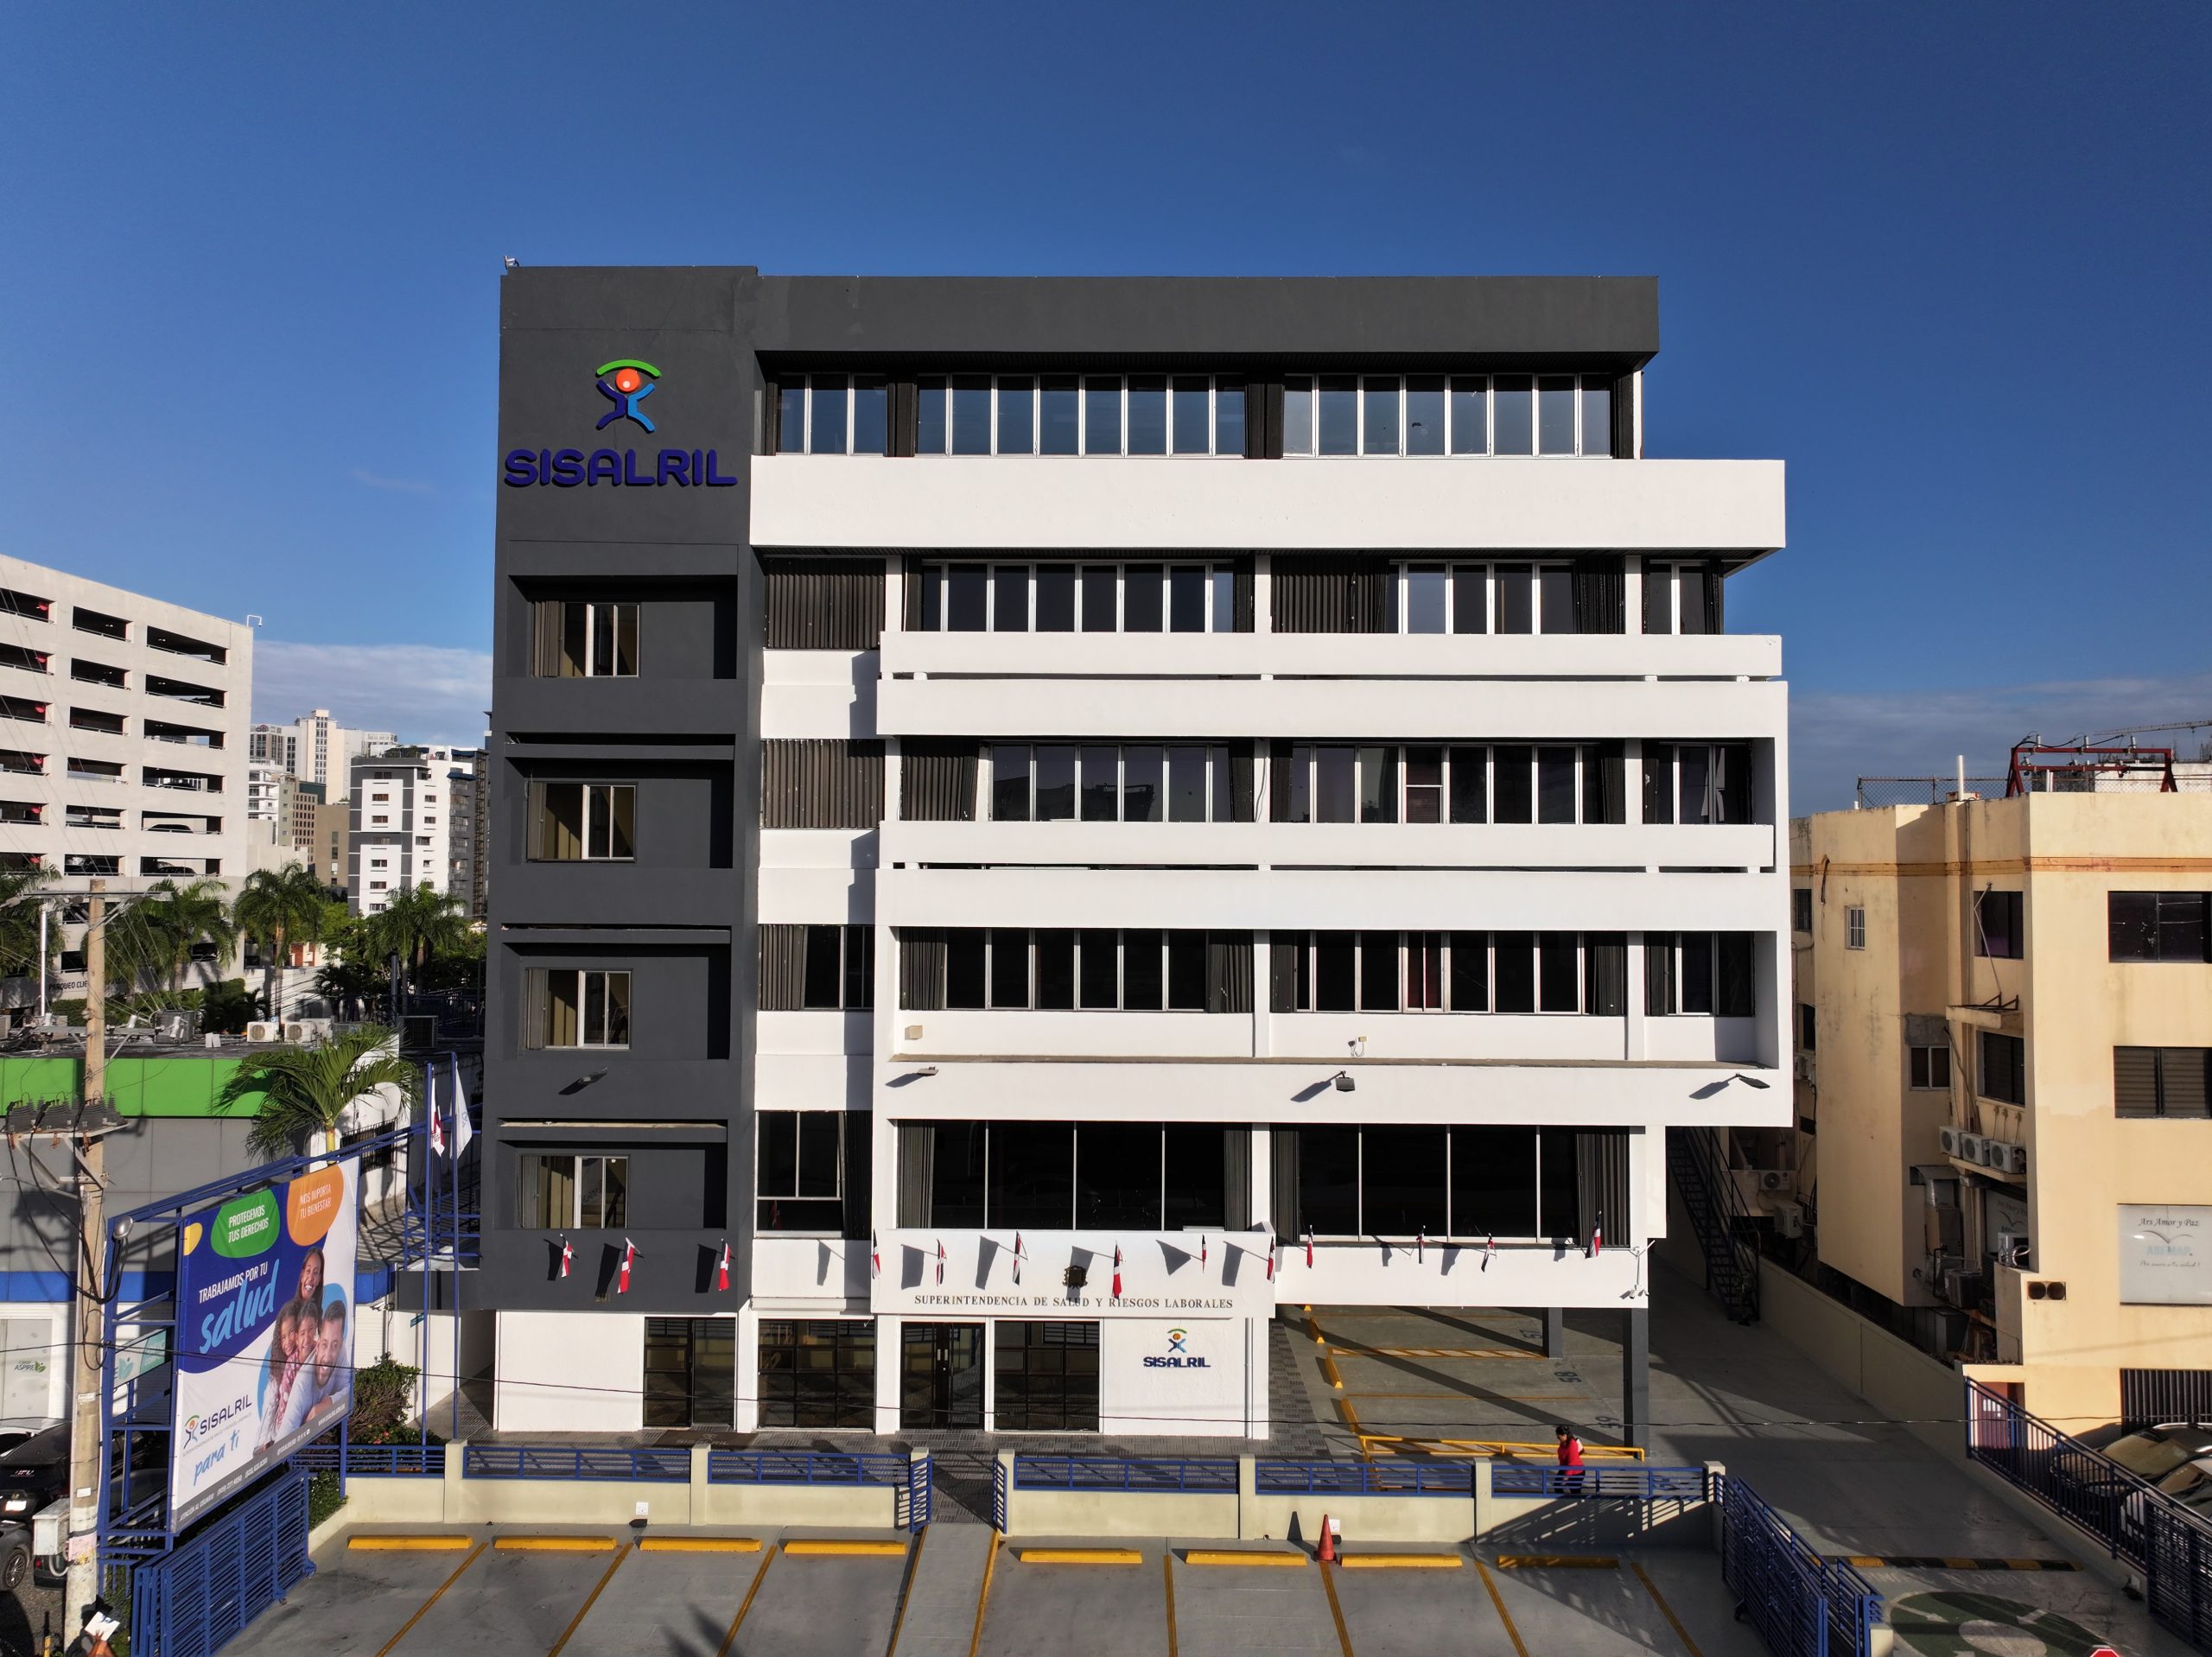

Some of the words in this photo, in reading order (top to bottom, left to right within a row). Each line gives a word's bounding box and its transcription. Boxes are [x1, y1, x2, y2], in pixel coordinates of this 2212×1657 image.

[505, 448, 738, 487] SISALRIL
[300, 1191, 311, 1206] NOS
[311, 1184, 332, 1202] IMPORTA
[228, 1204, 265, 1228] PROTEGEMOS
[300, 1208, 306, 1220] TU
[307, 1199, 332, 1216] BIENESTAR
[227, 1230, 240, 1243] TUS
[240, 1217, 270, 1239] DERECHOS
[2138, 1218, 2152, 1227] Ars
[2153, 1218, 2177, 1227] Amor
[2177, 1220, 2183, 1228] y
[2183, 1218, 2200, 1227] Paz
[199, 1272, 245, 1304] TRABAJAMOS
[245, 1265, 258, 1282] POR
[260, 1261, 268, 1277] TU
[200, 1258, 280, 1354] salud
[914, 1294, 1027, 1306] SUPERINTENDENCIA
[1033, 1296, 1048, 1306] DE
[1053, 1297, 1090, 1307] SALUD
[1096, 1298, 1103, 1307] Y
[1109, 1298, 1160, 1308] RIESGOS
[1165, 1298, 1233, 1309] LABORALES
[1143, 1355, 1211, 1368] SISALRIL
[1554, 1371, 1582, 1383] 58
[200, 1394, 252, 1435] SISALRIL
[194, 1443, 226, 1487] para
[230, 1429, 240, 1451] ti
